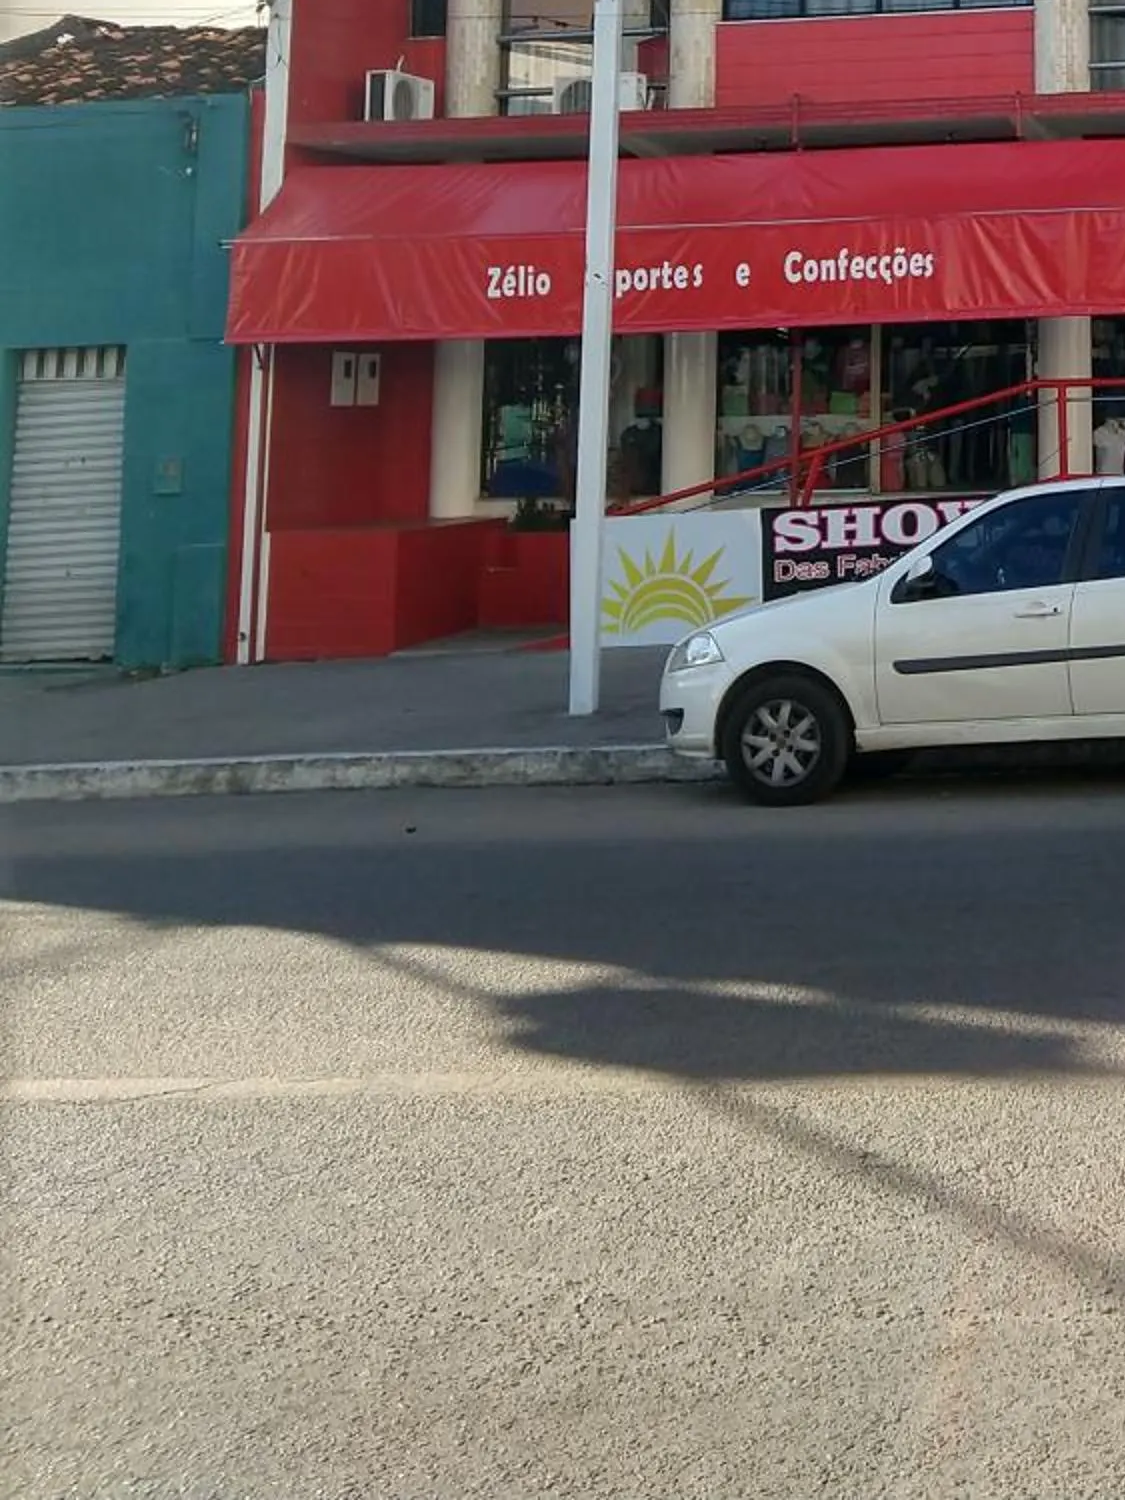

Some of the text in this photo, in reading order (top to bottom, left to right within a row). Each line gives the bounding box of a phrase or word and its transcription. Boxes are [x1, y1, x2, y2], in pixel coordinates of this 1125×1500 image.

[487, 246, 935, 299] Zélio portes e Confecções
[774, 559, 830, 583] Das
